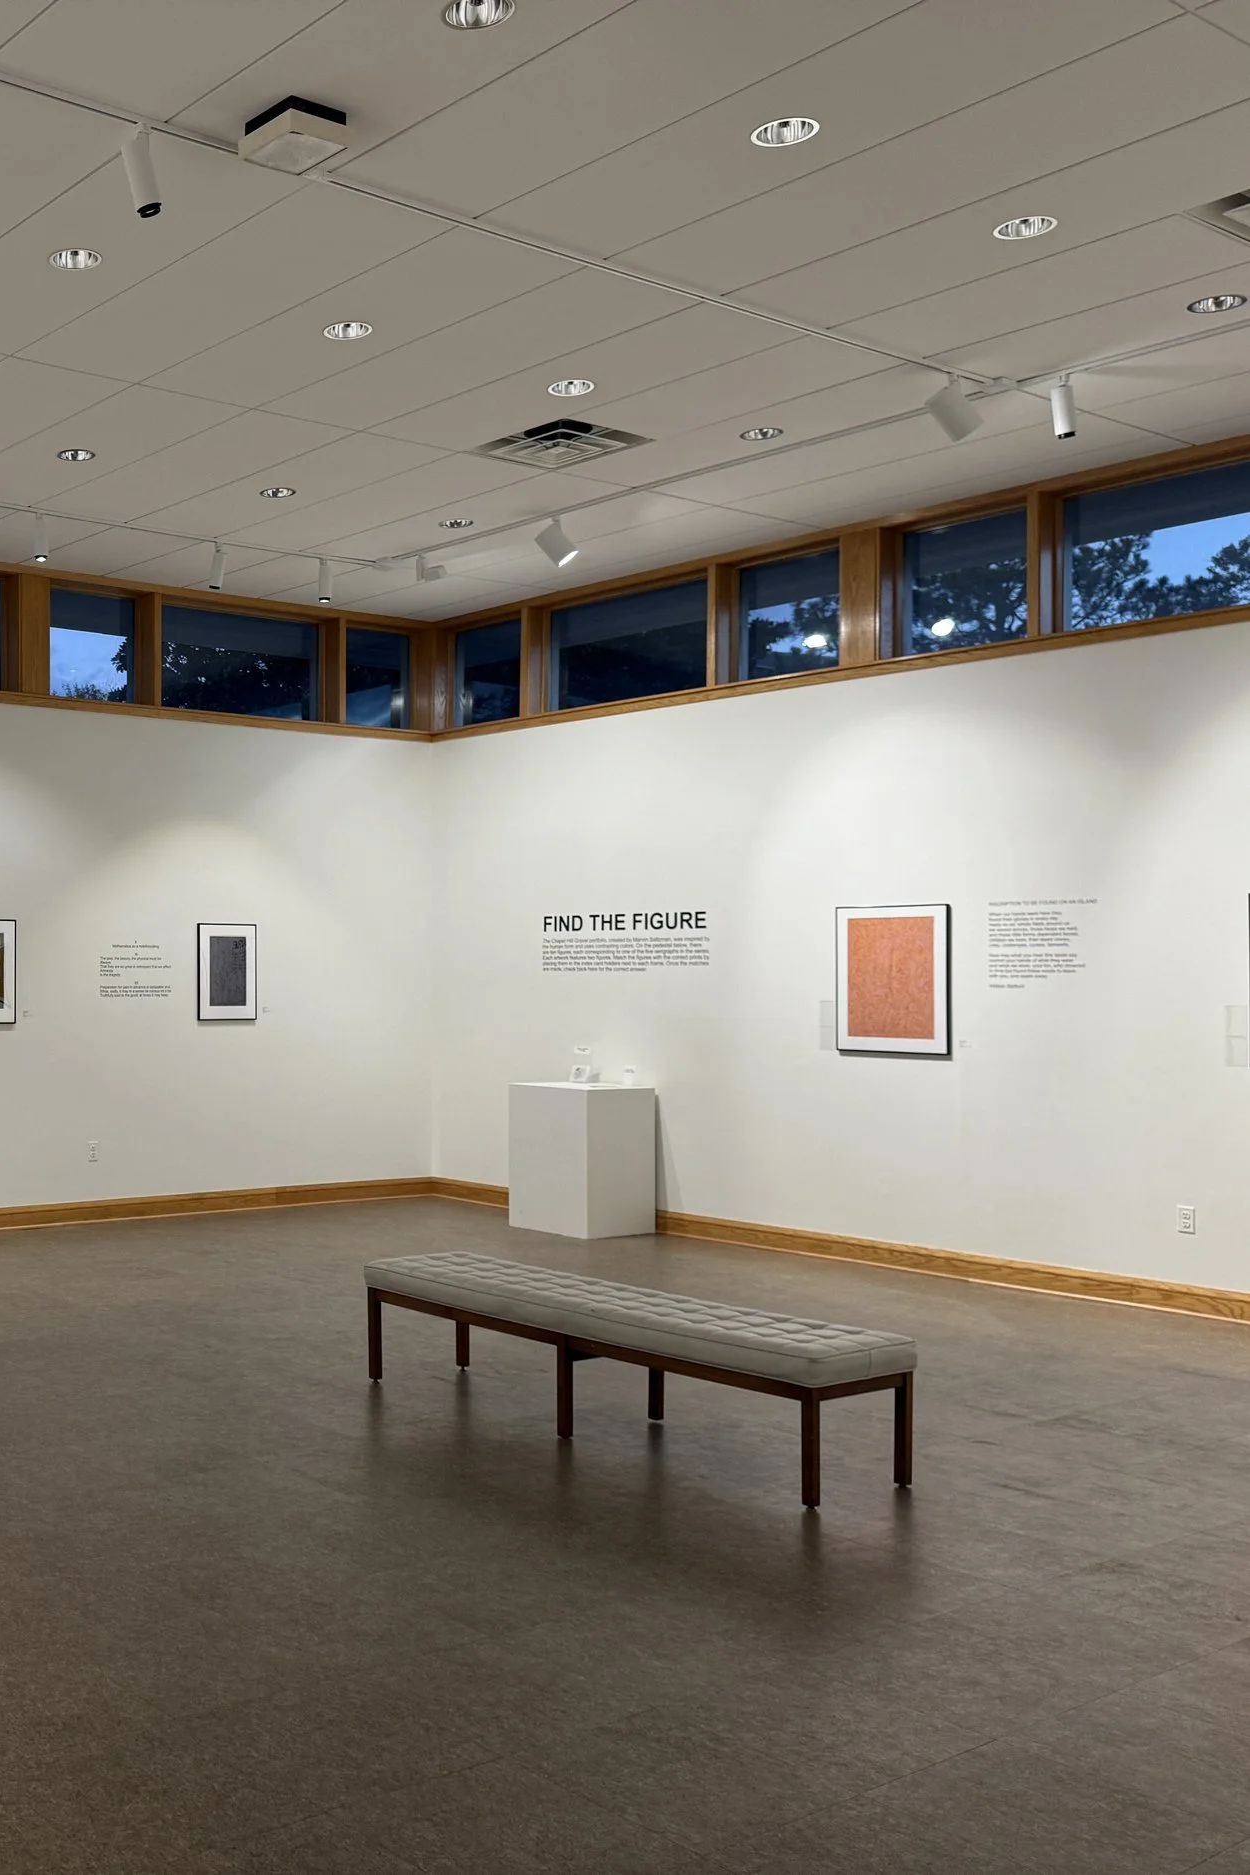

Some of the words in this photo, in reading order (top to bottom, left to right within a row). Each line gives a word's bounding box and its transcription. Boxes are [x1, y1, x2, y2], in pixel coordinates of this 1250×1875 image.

[544, 915, 583, 932] FIND
[589, 914, 625, 931] THE
[633, 912, 706, 930] FIGURE
